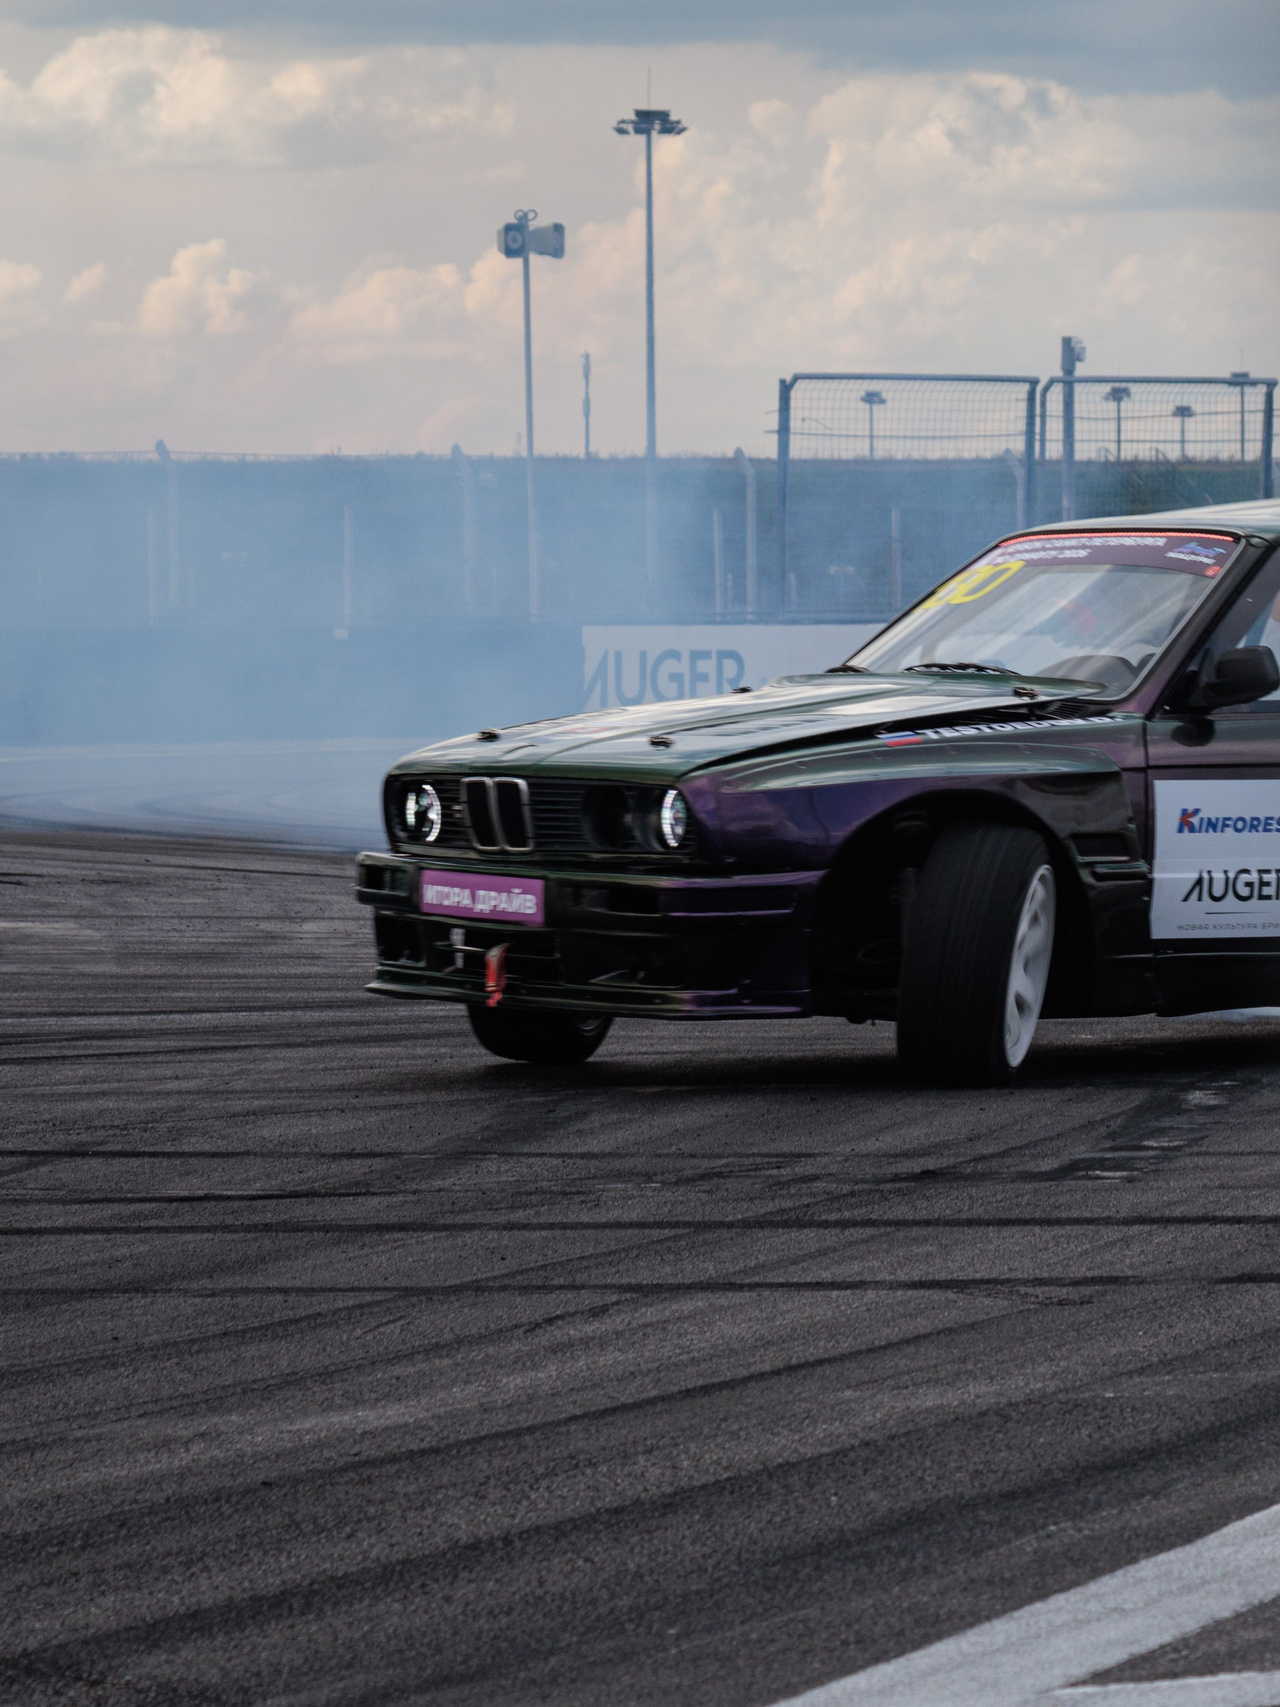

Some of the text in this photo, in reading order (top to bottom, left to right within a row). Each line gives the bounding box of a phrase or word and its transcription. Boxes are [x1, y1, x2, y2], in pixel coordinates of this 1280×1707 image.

[583, 649, 745, 705] AUGER
[423, 884, 538, 914] ИГОРА ДРАЙВ
